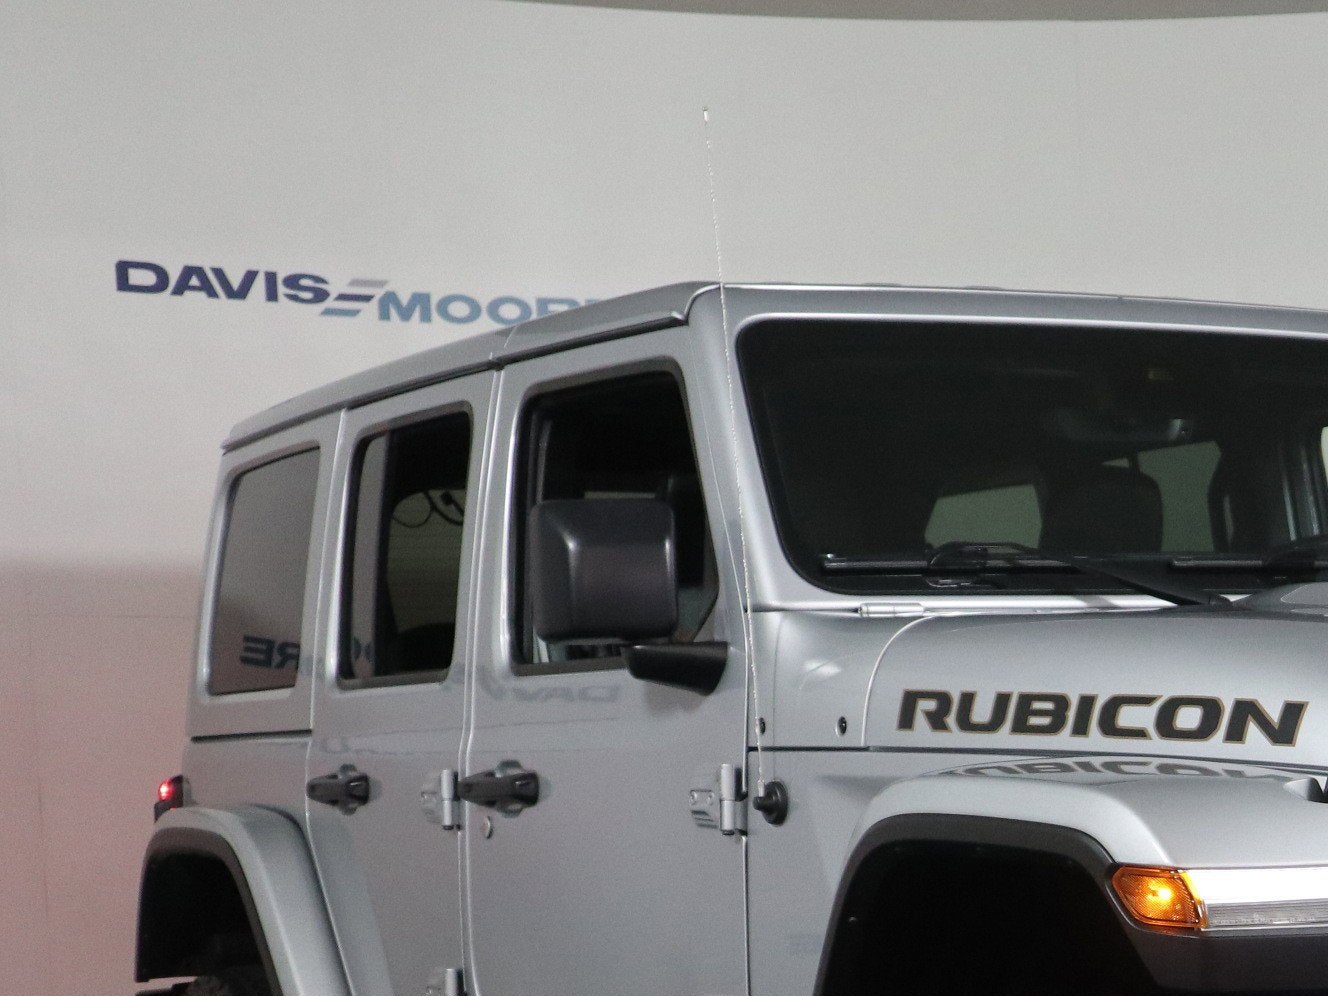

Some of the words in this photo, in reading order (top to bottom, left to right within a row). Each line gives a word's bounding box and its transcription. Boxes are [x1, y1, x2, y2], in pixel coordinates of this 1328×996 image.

[114, 259, 331, 306] DAVIS
[378, 290, 606, 325] MOO
[896, 688, 1308, 748] RUBICON
